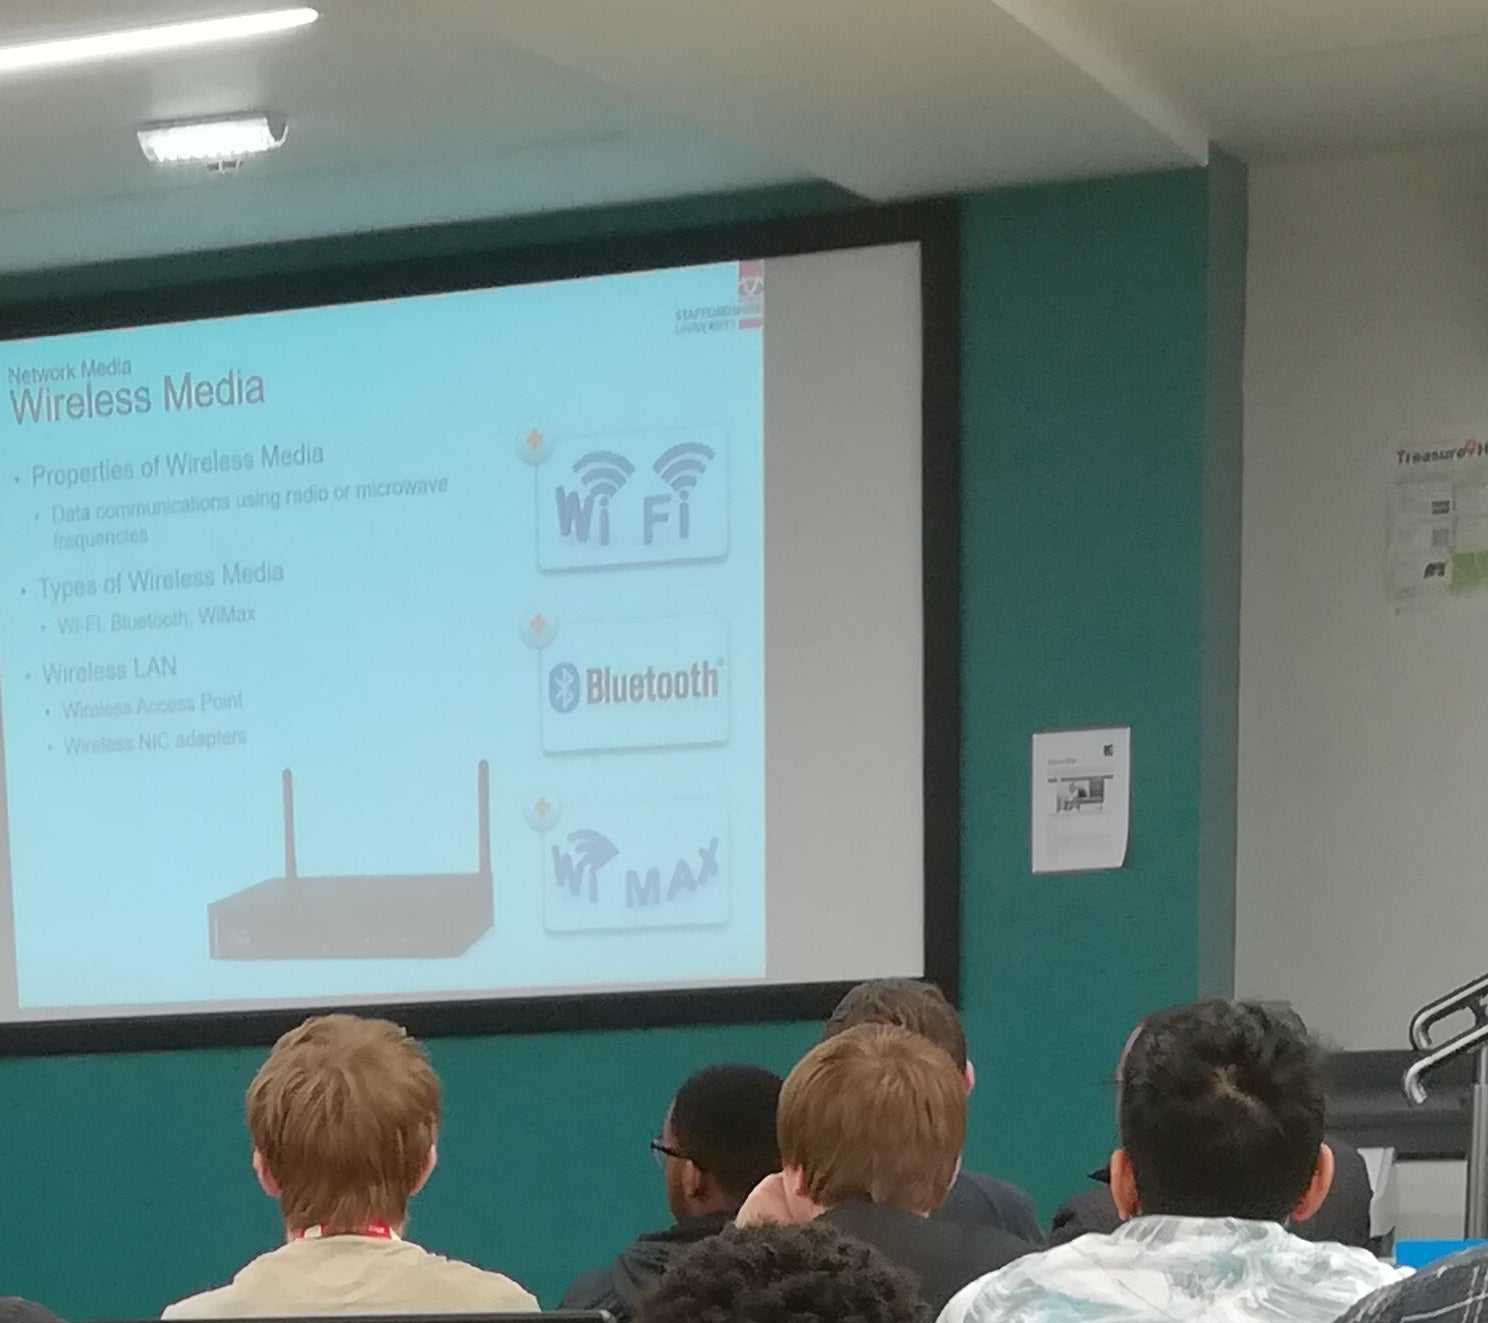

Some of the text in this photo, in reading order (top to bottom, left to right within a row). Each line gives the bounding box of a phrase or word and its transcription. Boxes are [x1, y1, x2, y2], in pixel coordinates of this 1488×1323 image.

[8, 359, 133, 386] Network Media
[10, 369, 265, 425] Wireless Media
[32, 442, 324, 489] Properties of Wireless Media
[52, 477, 449, 524] Data communications using radio or microwave
[555, 484, 690, 546] Wi Fi
[54, 528, 149, 552] frequencies
[39, 561, 285, 603] Types of Wireless Media
[198, 604, 257, 625] WiMax
[42, 655, 178, 685] Wireless LAN
[586, 660, 719, 705] Bluetooth
[61, 690, 244, 721] Wireless Access Point
[63, 728, 247, 756] Wireless NIC adapters
[625, 836, 719, 909] MAX
